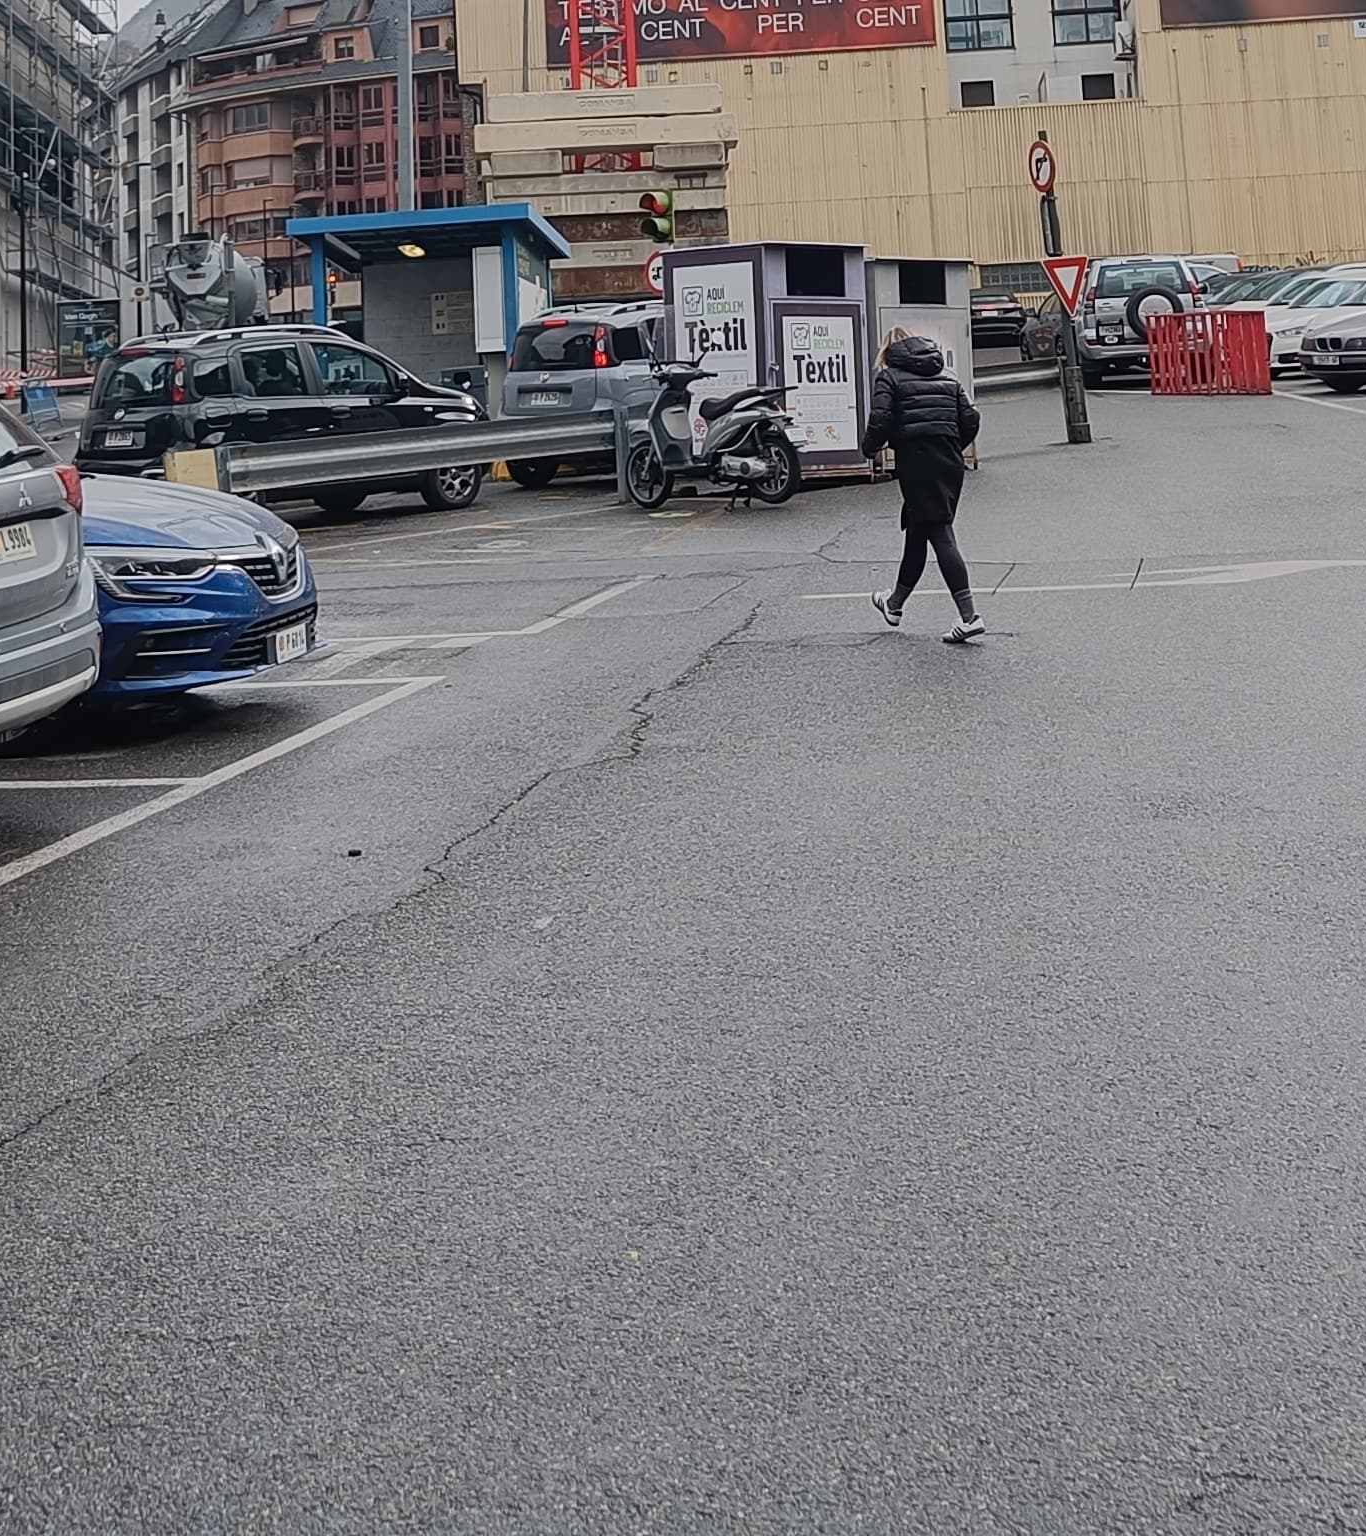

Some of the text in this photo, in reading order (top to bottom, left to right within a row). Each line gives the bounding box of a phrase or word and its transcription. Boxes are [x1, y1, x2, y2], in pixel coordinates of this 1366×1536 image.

[640, 18, 705, 41] CENT
[758, 13, 804, 34] PER
[856, 4, 921, 28] CENT
[707, 301, 744, 315] RECICLEM
[792, 353, 848, 384] Tèxtil
